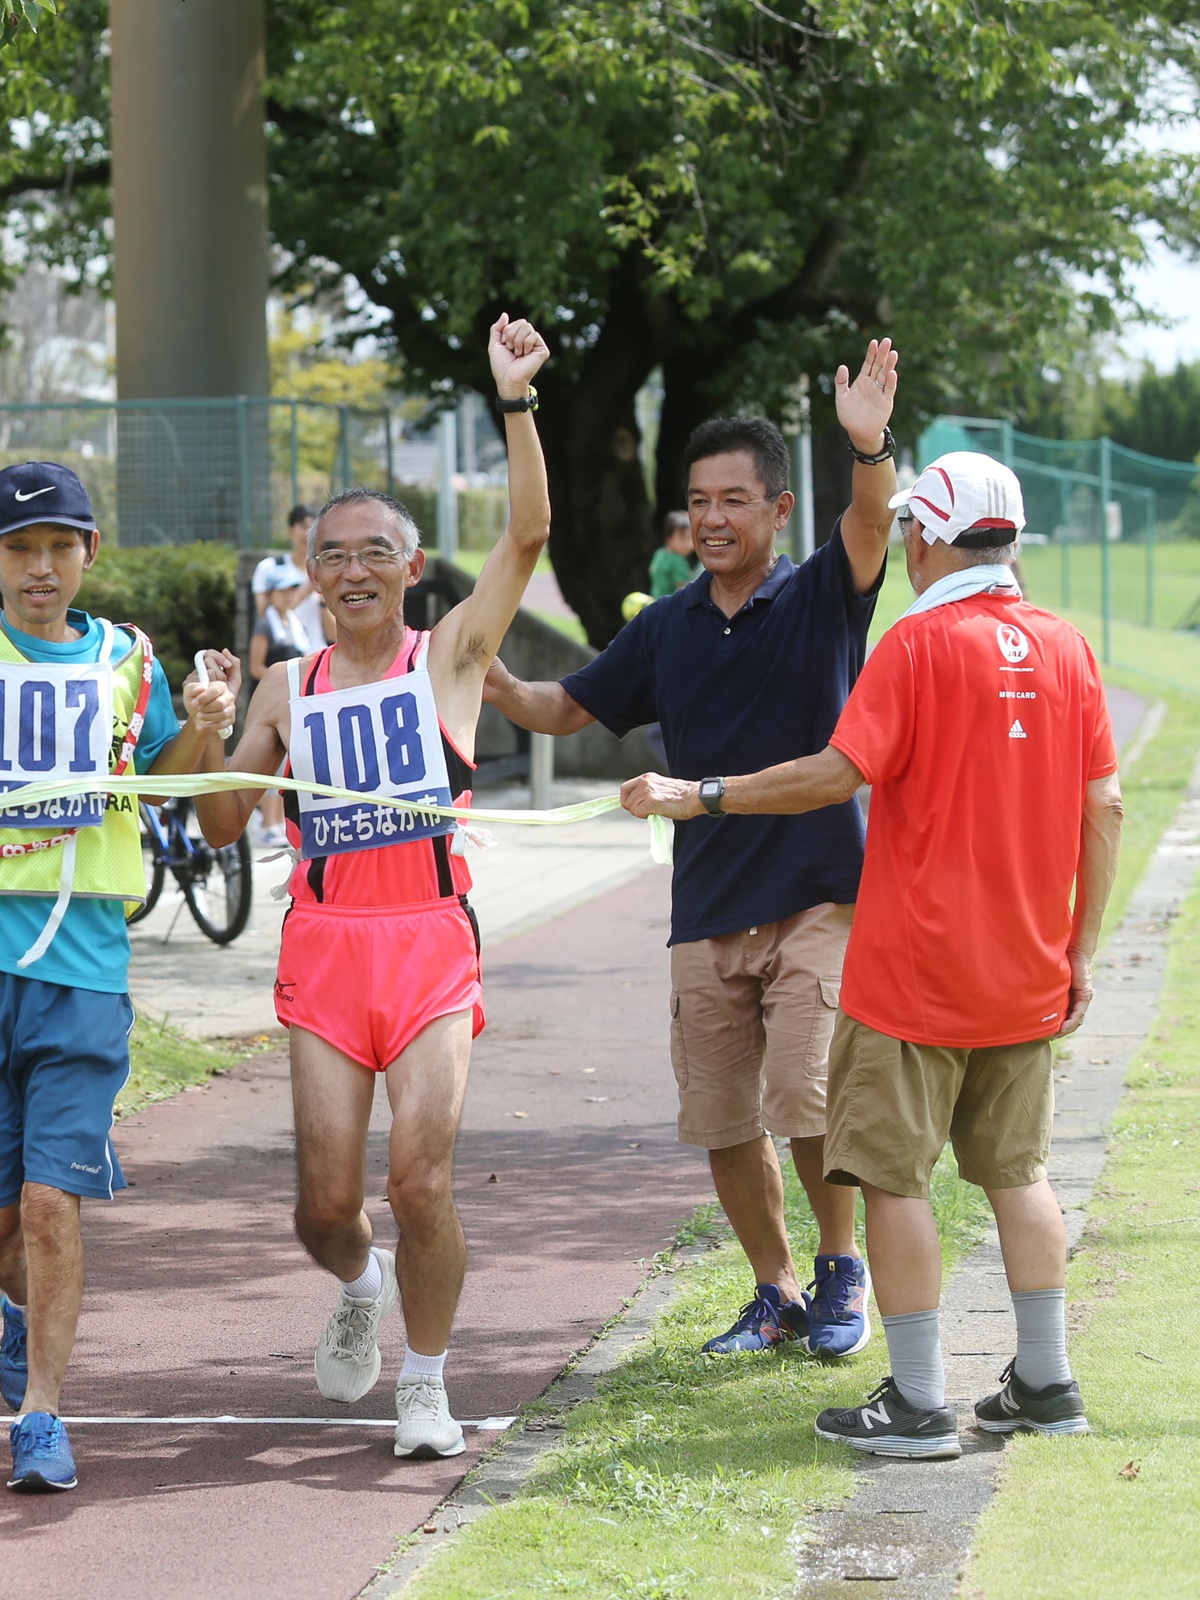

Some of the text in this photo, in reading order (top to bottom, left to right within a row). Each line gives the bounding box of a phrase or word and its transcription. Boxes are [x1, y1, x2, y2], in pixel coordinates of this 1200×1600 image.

[1007, 650, 1024, 658] JAL
[1017, 691, 1036, 699] CARD
[304, 692, 426, 799] 108
